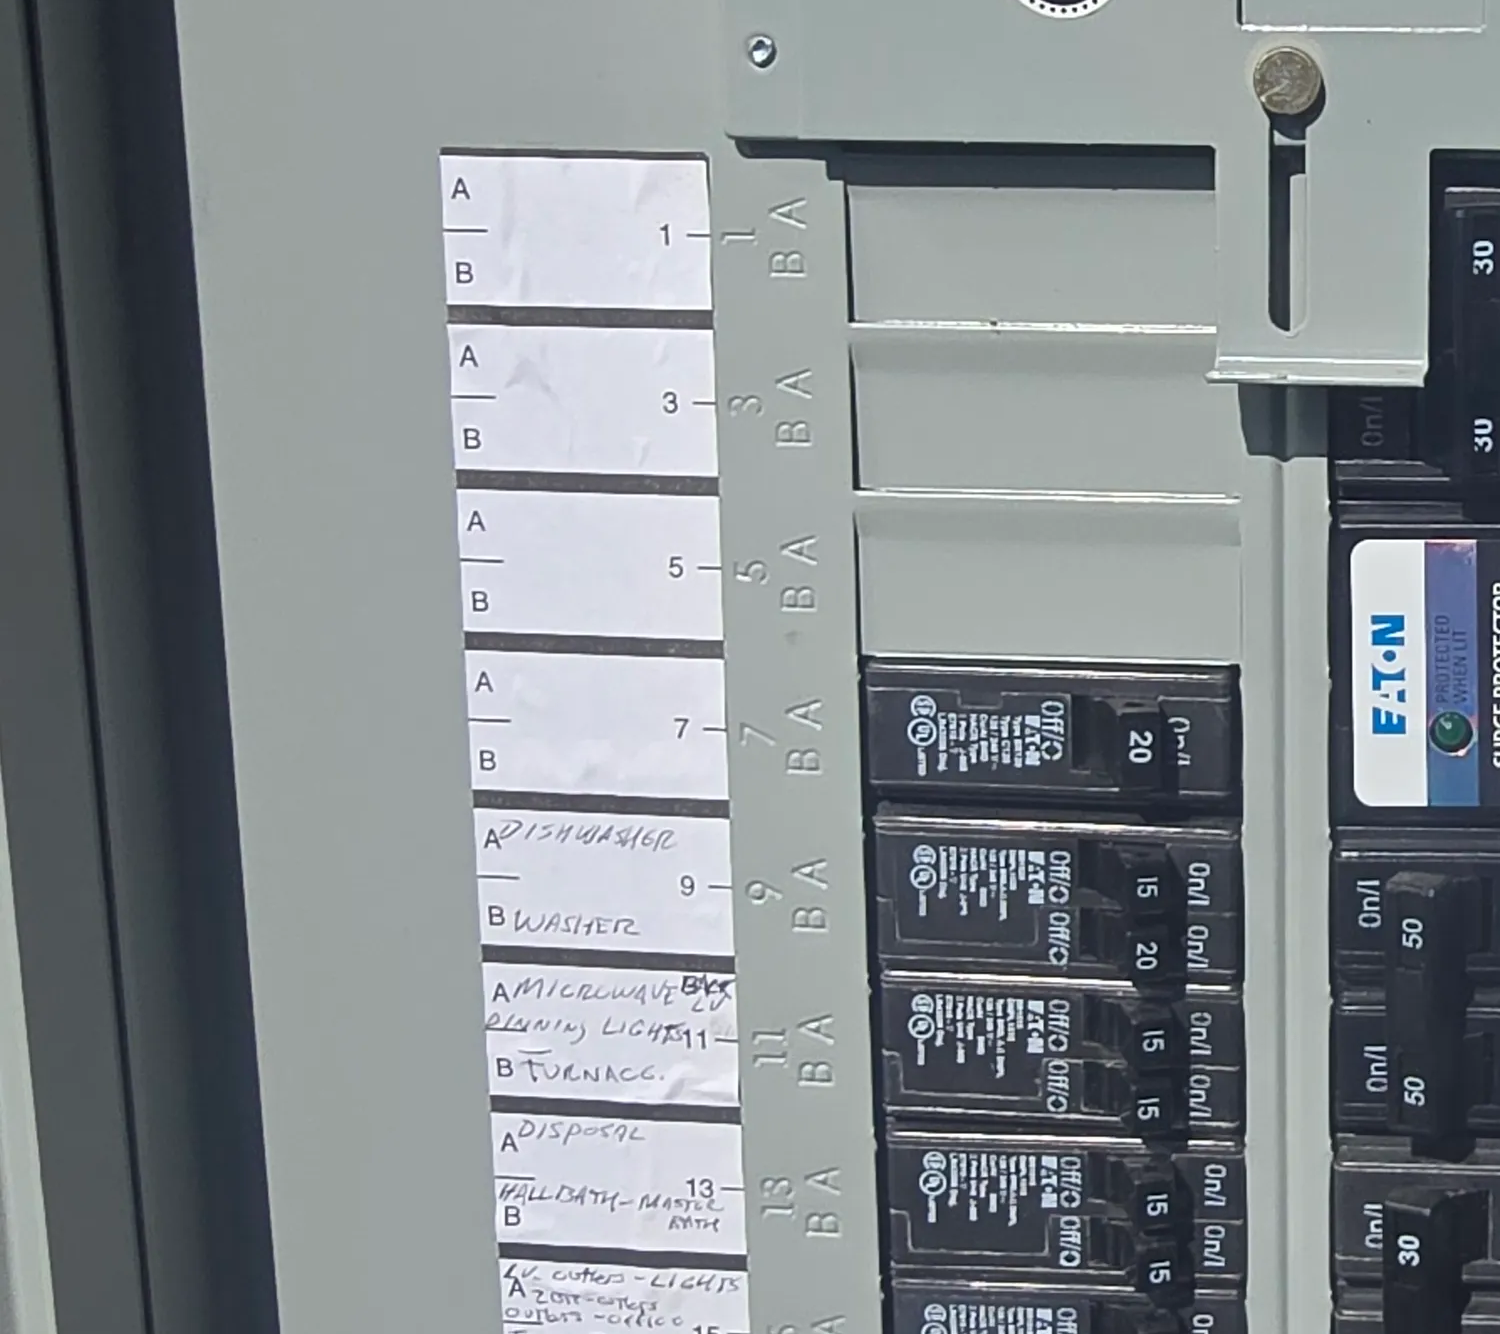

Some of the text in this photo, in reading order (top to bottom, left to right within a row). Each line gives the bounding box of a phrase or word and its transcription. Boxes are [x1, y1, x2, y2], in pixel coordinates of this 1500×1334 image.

[452, 178, 470, 199] A
[660, 224, 669, 245] 1
[1474, 241, 1493, 274] 30
[456, 262, 473, 283] B
[460, 345, 478, 367] A
[663, 392, 678, 413] 3
[464, 428, 481, 449] B
[1475, 419, 1492, 452] 30
[670, 557, 683, 578] 5
[1433, 615, 1451, 704] PROTECTED
[1452, 629, 1469, 705] WHEN LIT
[1370, 615, 1406, 735] EATON
[675, 718, 688, 738] 7
[1129, 731, 1152, 763] 20
[681, 875, 694, 896] 9
[1137, 878, 1157, 897] 15
[514, 909, 641, 936] WASHER
[1403, 919, 1422, 949] 50
[1136, 942, 1157, 969] 20
[683, 1029, 705, 1049] 11
[1143, 1031, 1164, 1051] 15
[1404, 1077, 1424, 1105] 50
[1138, 1098, 1159, 1120] 15
[687, 1179, 713, 1198] 13
[1147, 1194, 1167, 1215] 15
[1398, 1236, 1419, 1266] 30
[1150, 1261, 1170, 1283] 15
